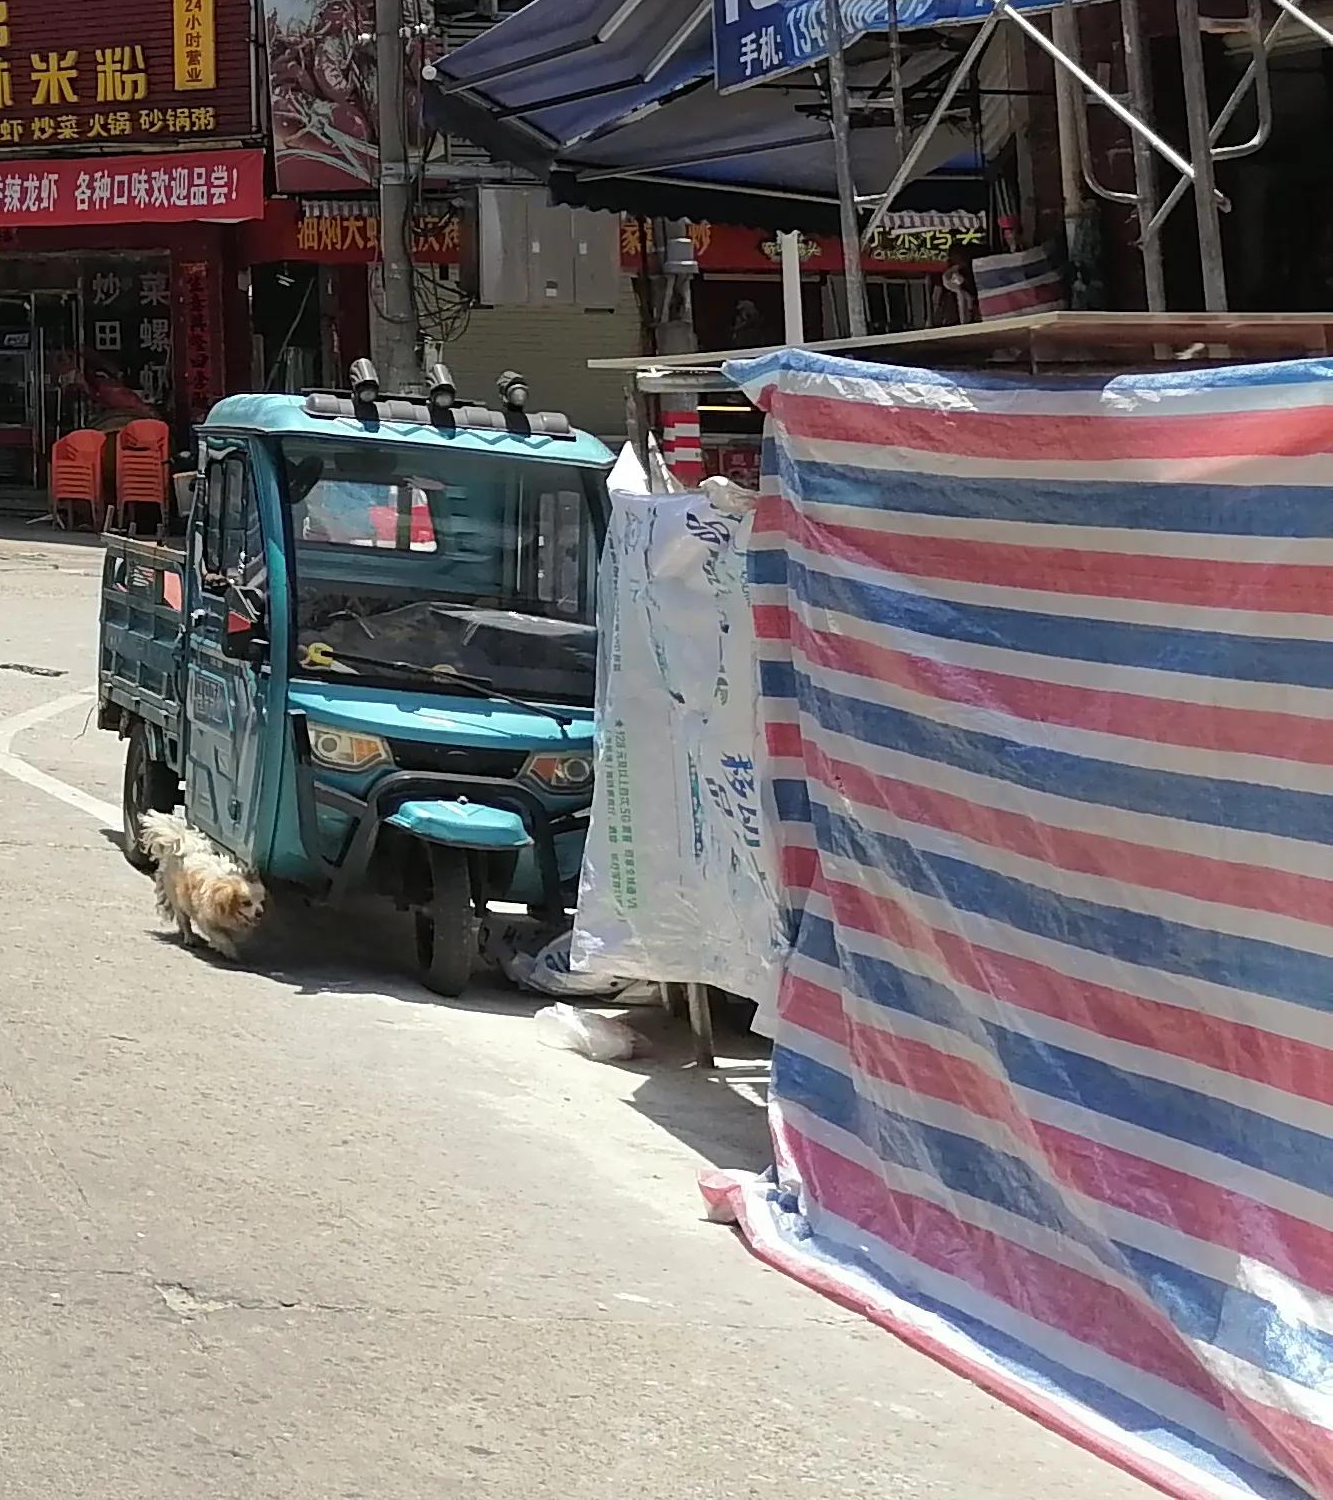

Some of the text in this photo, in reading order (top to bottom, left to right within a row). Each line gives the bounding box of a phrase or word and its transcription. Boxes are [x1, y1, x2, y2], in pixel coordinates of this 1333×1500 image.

[31, 114, 83, 141] 炒菜
[86, 111, 133, 139] 火锅
[139, 106, 217, 135] 砂锅粥
